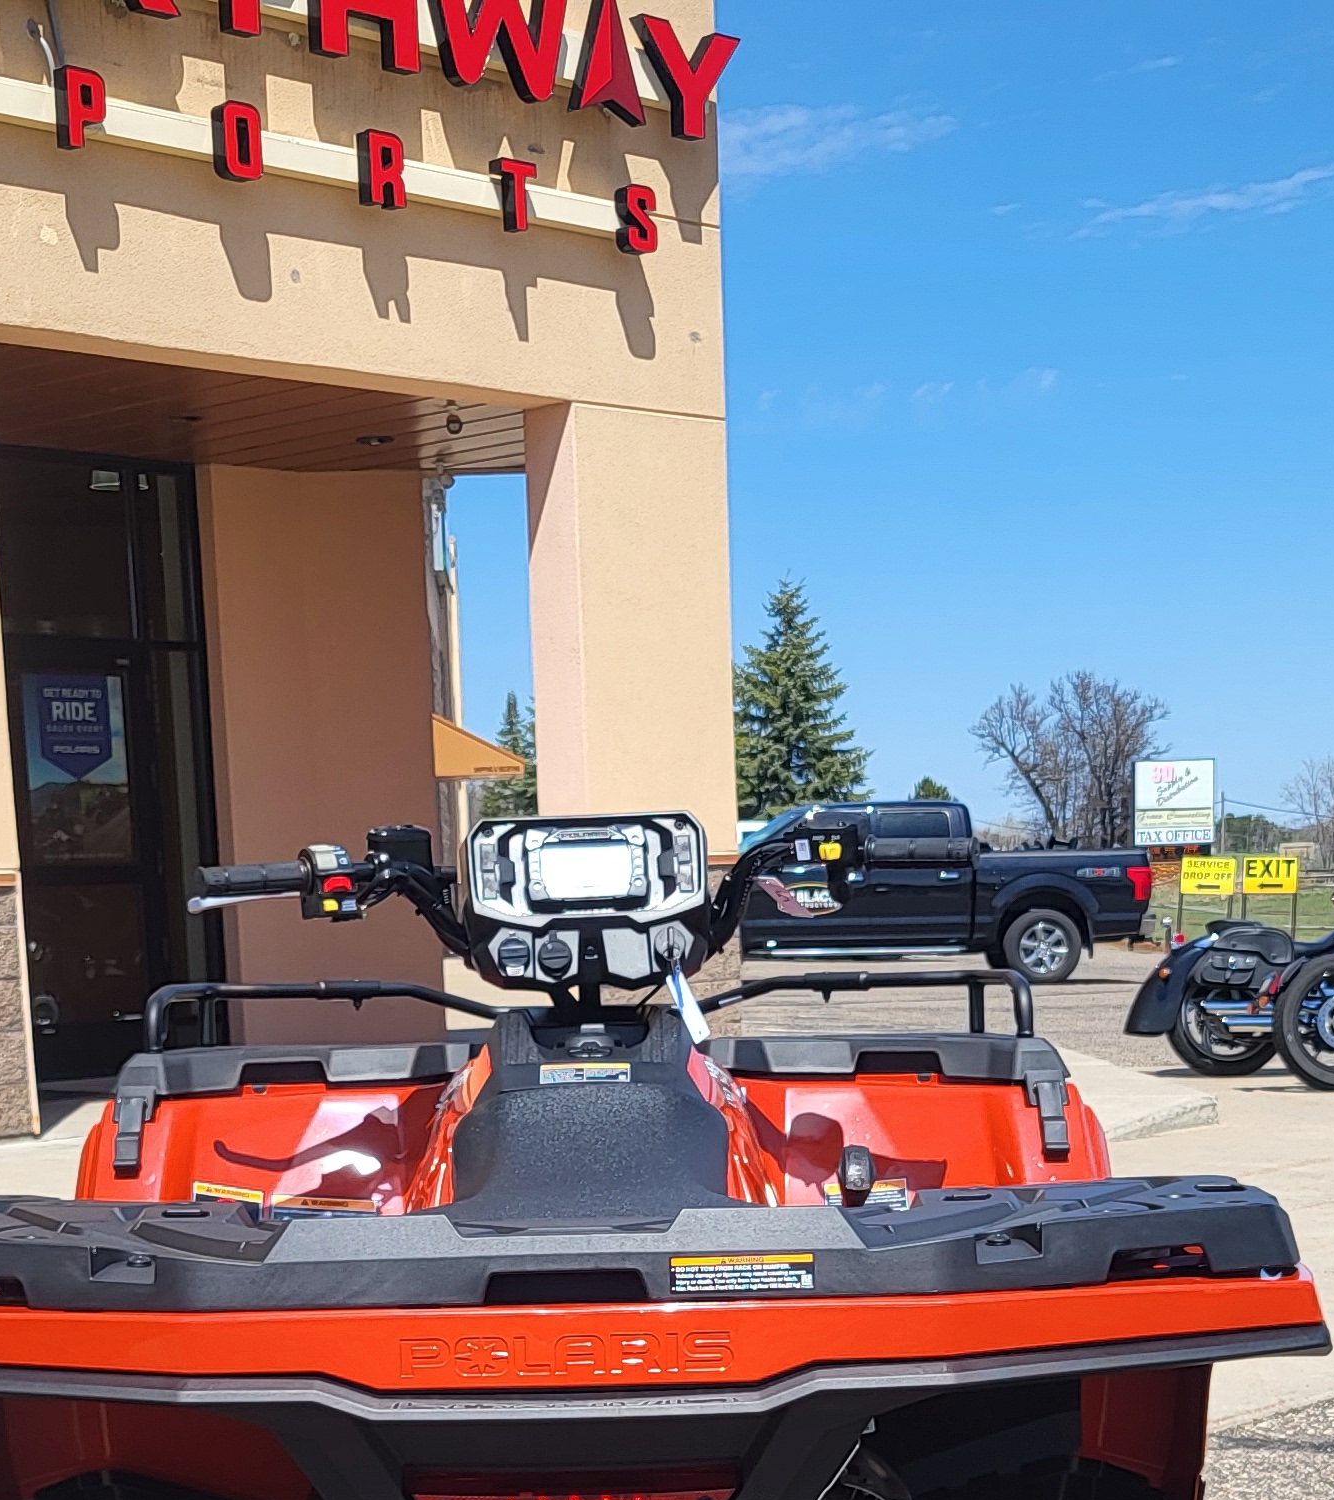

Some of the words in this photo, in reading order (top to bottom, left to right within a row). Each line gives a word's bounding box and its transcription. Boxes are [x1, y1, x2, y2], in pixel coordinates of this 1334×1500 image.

[124, 0, 741, 140] HWAY
[51, 701, 97, 722] RIDE
[1137, 830, 1162, 843] TAX
[1166, 828, 1212, 843] OFFICE
[1186, 860, 1231, 869] SERVICE
[1246, 859, 1296, 879] EXIT
[1182, 872, 1211, 880] DROP
[1213, 872, 1233, 881] OFF
[796, 888, 834, 903] BLAC
[727, 1256, 765, 1264] WARNING
[399, 1330, 735, 1380] POLARIS
